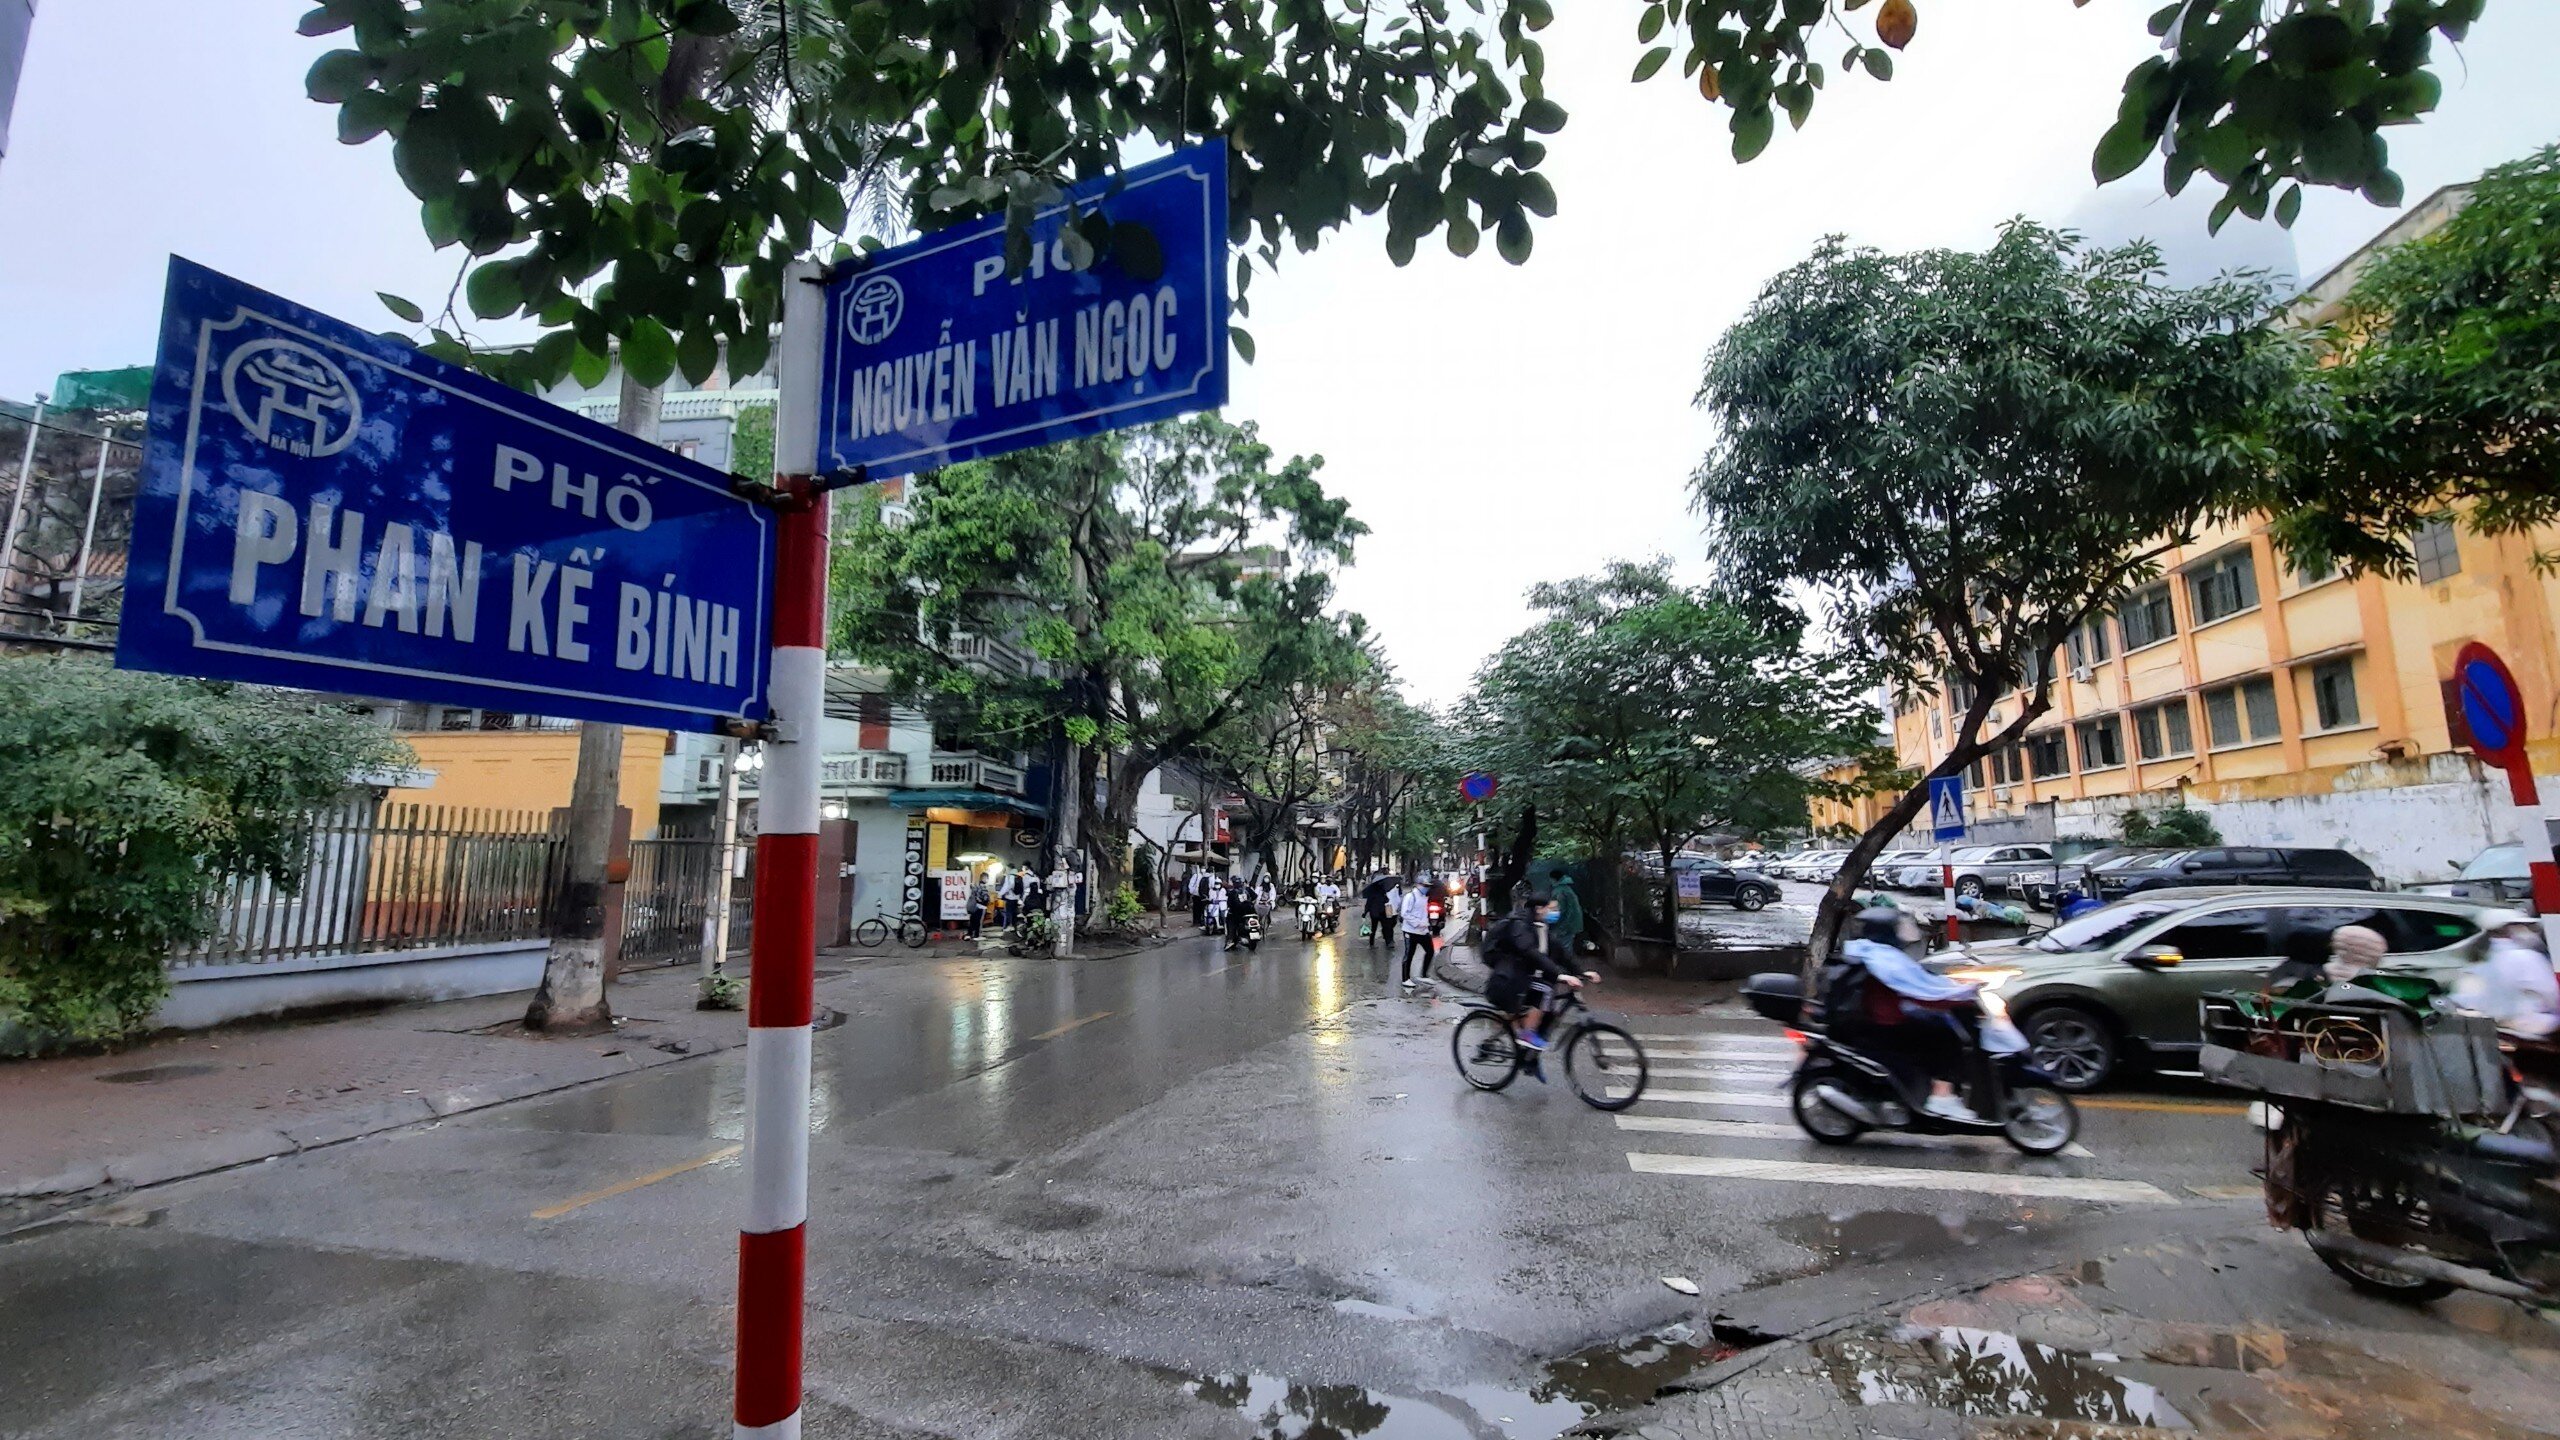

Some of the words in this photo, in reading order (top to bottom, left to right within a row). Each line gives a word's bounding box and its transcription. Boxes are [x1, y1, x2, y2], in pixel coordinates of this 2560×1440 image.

[851, 318, 976, 440] NGUYỄN
[992, 304, 1058, 408] VĂN
[1075, 285, 1177, 394] NGỌC
[493, 443, 662, 532] PHỐ
[229, 489, 483, 643] PHAN
[508, 546, 605, 663] KẾ
[616, 573, 740, 687] BÍNH
